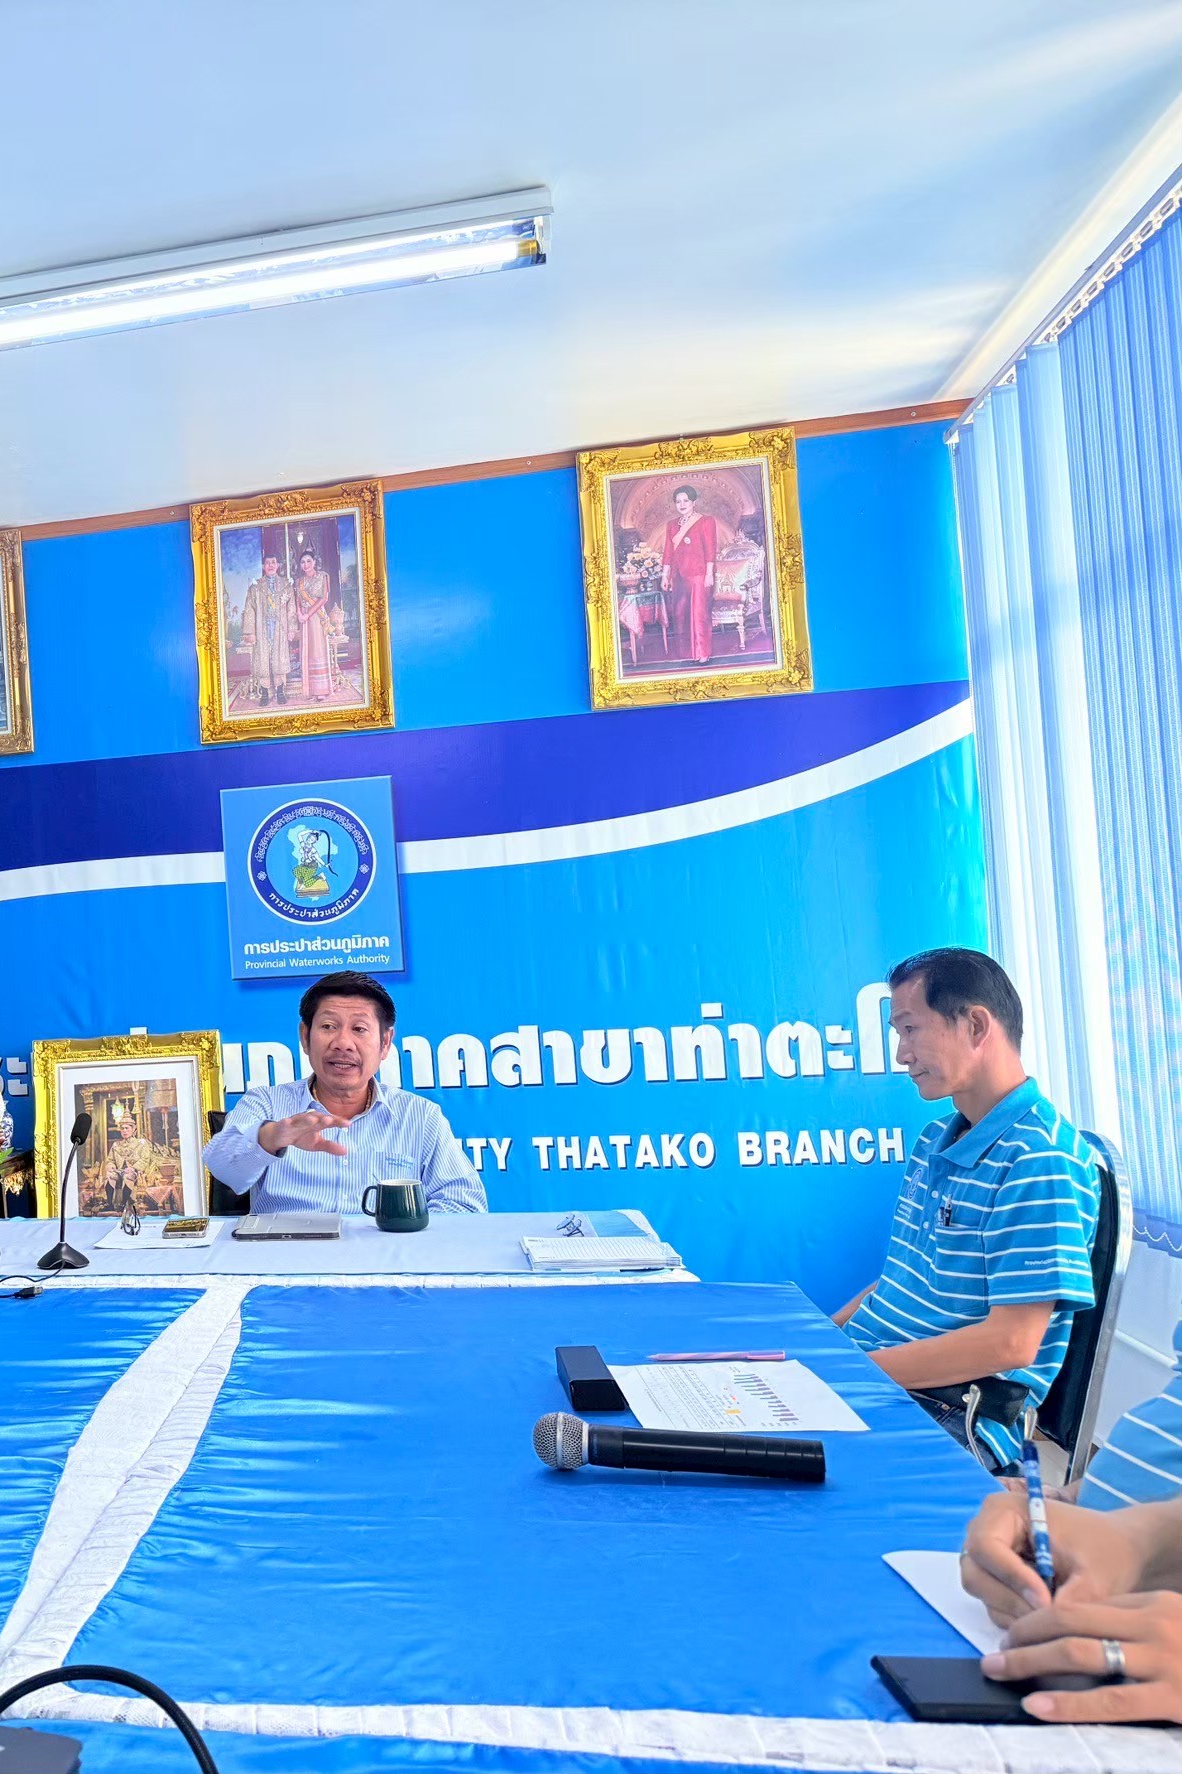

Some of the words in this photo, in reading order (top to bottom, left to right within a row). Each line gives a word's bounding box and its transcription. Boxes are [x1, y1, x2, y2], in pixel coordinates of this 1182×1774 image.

[244, 934, 390, 955] การประปาส่วนภูมิภาค
[244, 958, 287, 970] Provincial
[288, 955, 344, 968] Waterworks
[346, 952, 391, 966] Authority
[458, 1137, 512, 1171] TY
[531, 1132, 716, 1170] THATAKO
[737, 1126, 905, 1167] BRANCH
